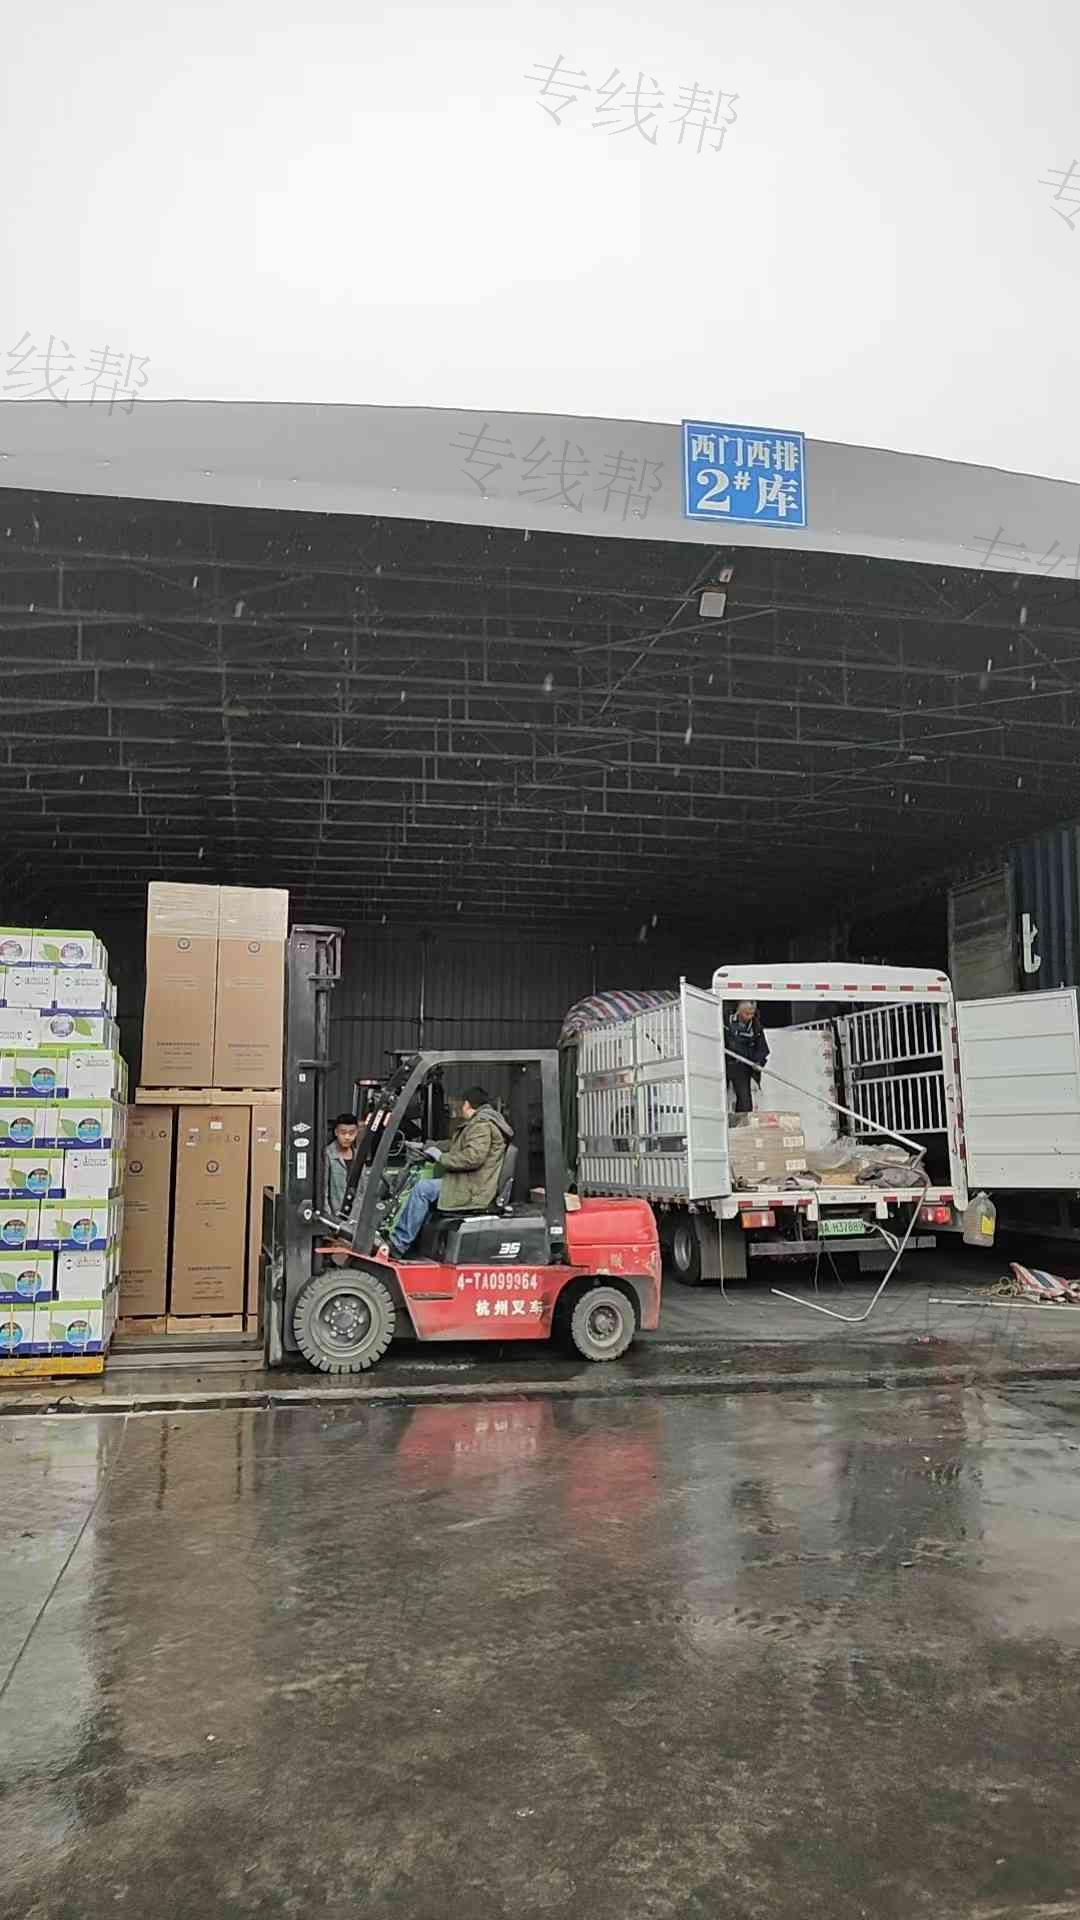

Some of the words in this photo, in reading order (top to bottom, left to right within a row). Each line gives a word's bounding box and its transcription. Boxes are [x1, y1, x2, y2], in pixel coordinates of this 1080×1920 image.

[689, 432, 800, 472] 西门西排
[498, 1242, 521, 1254] 35
[475, 1299, 544, 1317] 杭州叉车
